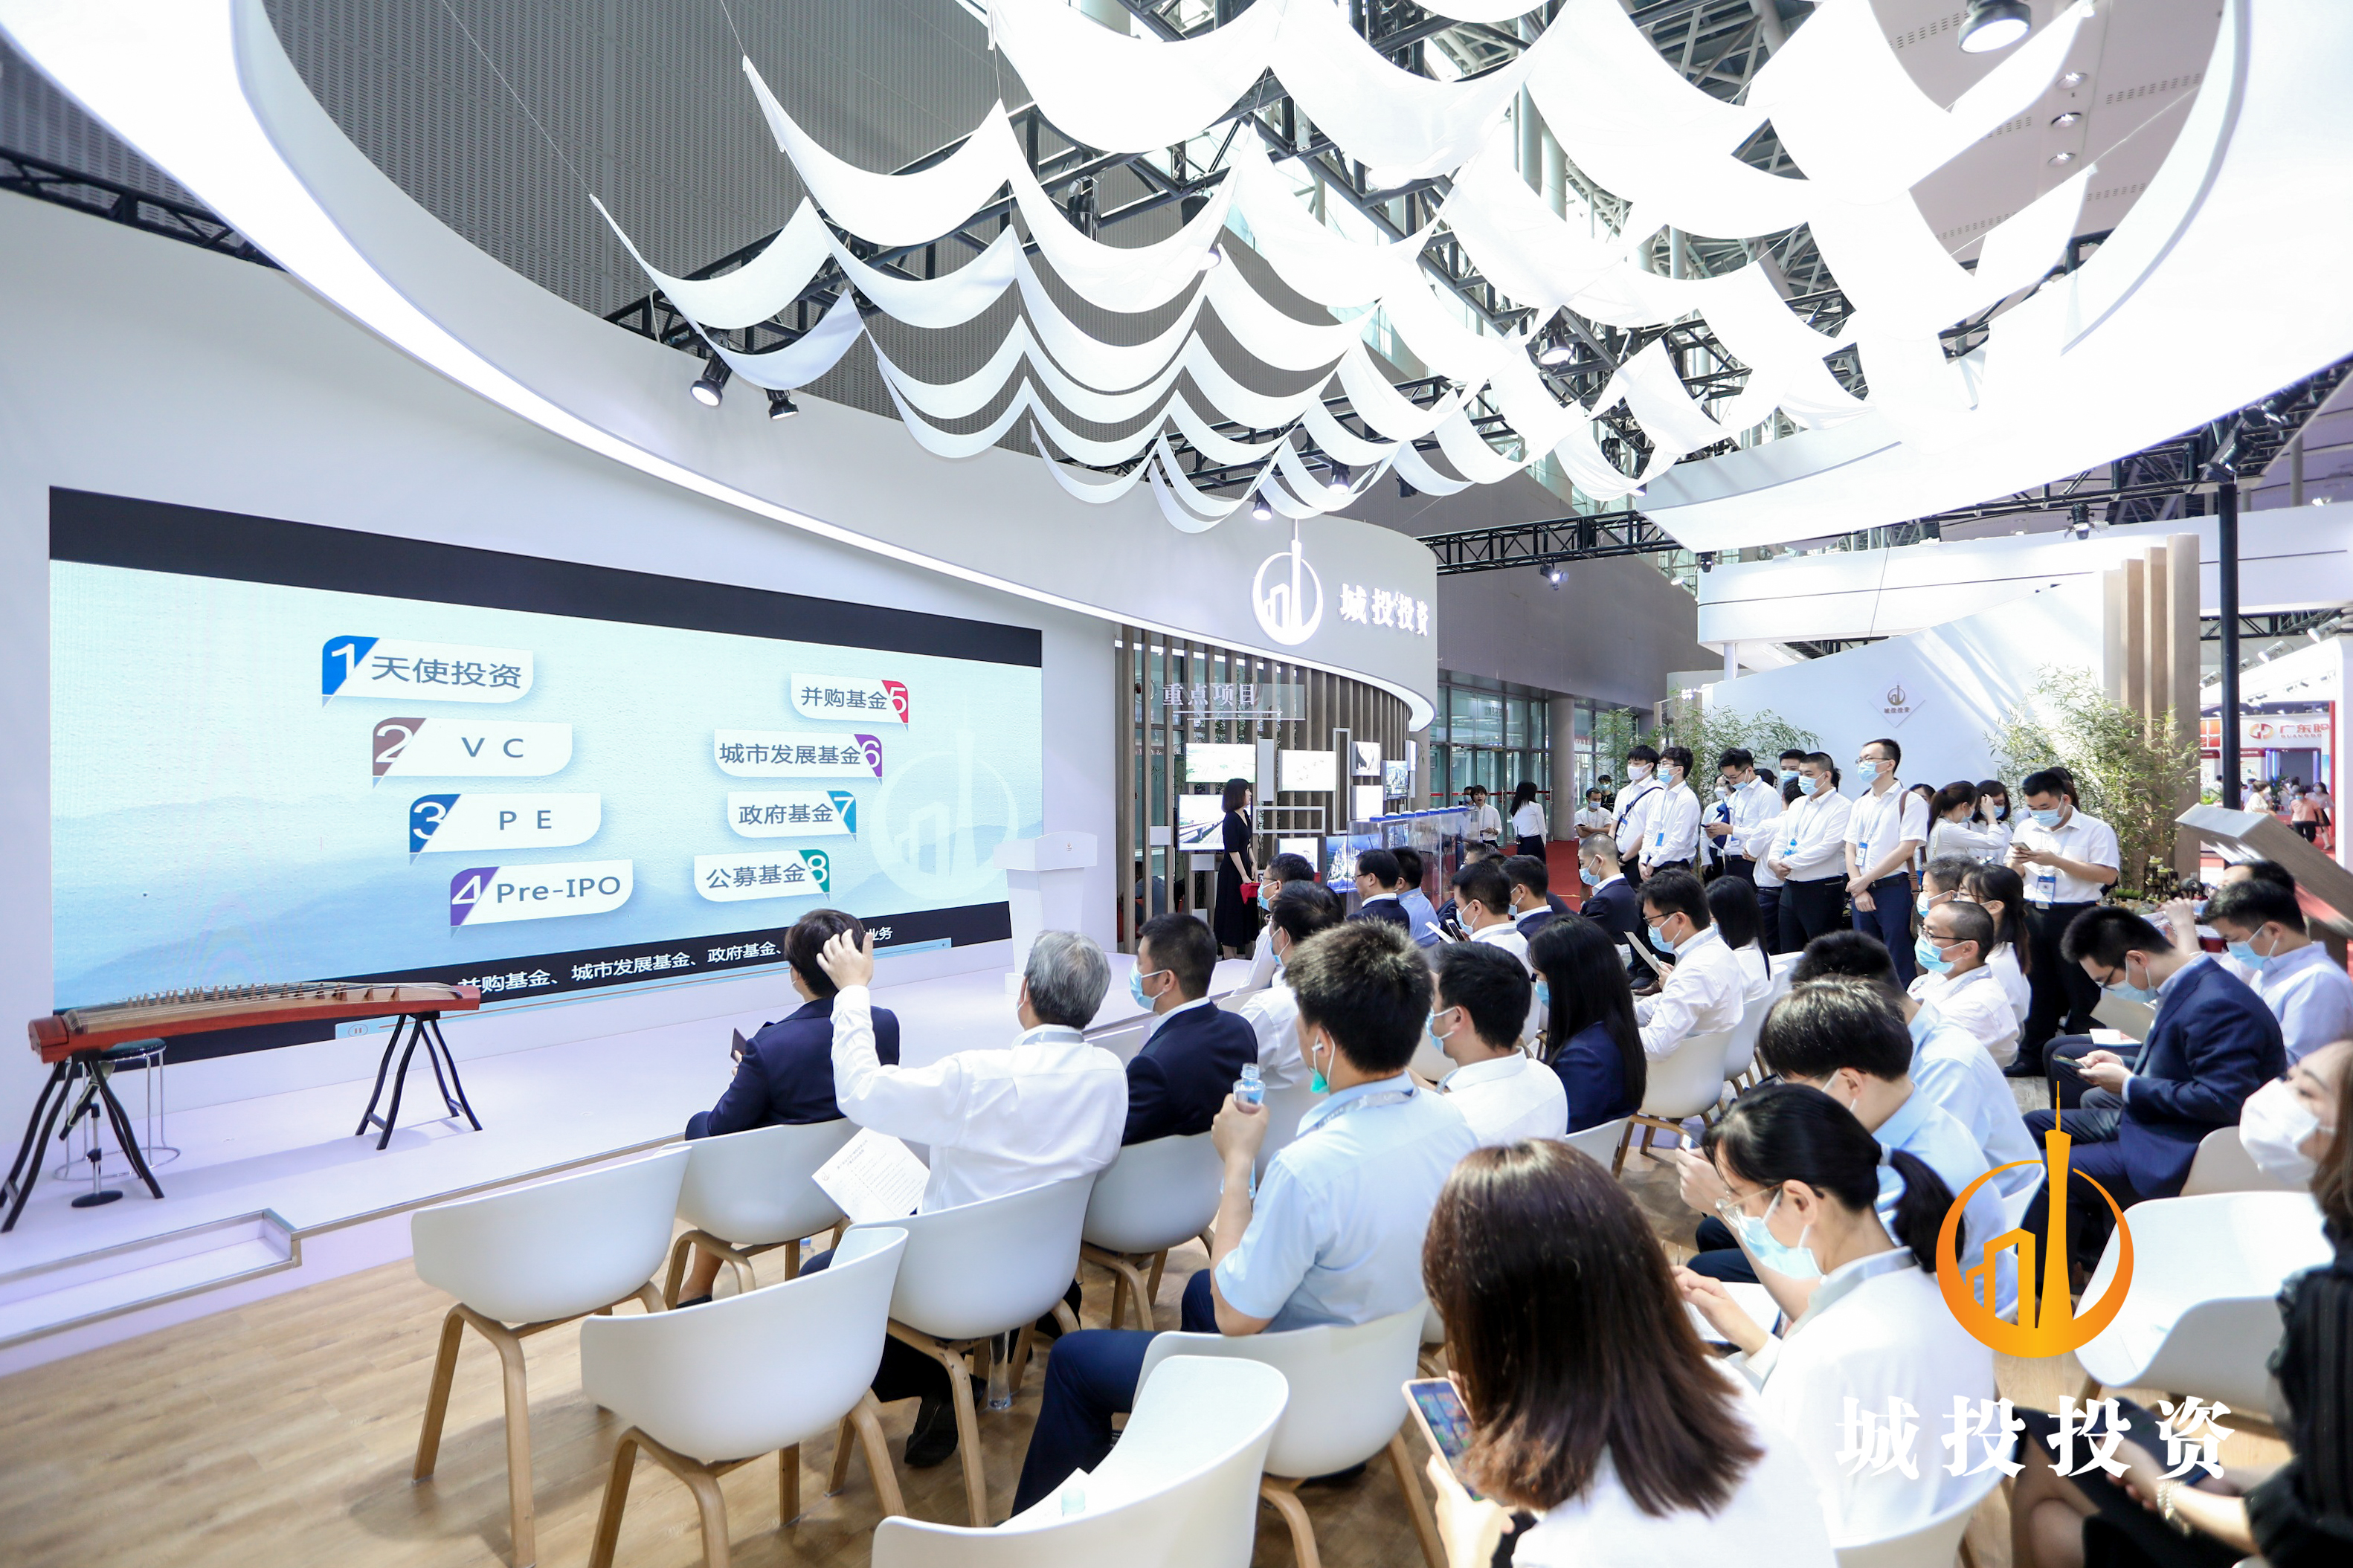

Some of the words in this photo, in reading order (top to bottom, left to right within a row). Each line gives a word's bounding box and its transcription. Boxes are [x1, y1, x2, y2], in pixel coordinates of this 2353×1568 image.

[1338, 583, 1429, 637] 城投投资
[332, 643, 355, 680] 1
[371, 656, 522, 689] 天使投资
[800, 686, 888, 711] 并购基金
[889, 686, 907, 714] 5
[1162, 683, 1255, 706] 重点项目
[375, 724, 414, 764] 2
[719, 742, 862, 766] 城市发展基金
[862, 739, 881, 769] 6
[412, 801, 447, 841] 3
[738, 803, 834, 825] 政府基金
[834, 796, 855, 820] 7
[705, 862, 807, 888] 公募基金
[807, 854, 828, 885] 8
[451, 874, 482, 906] 4
[497, 877, 621, 904] Pre-IPO
